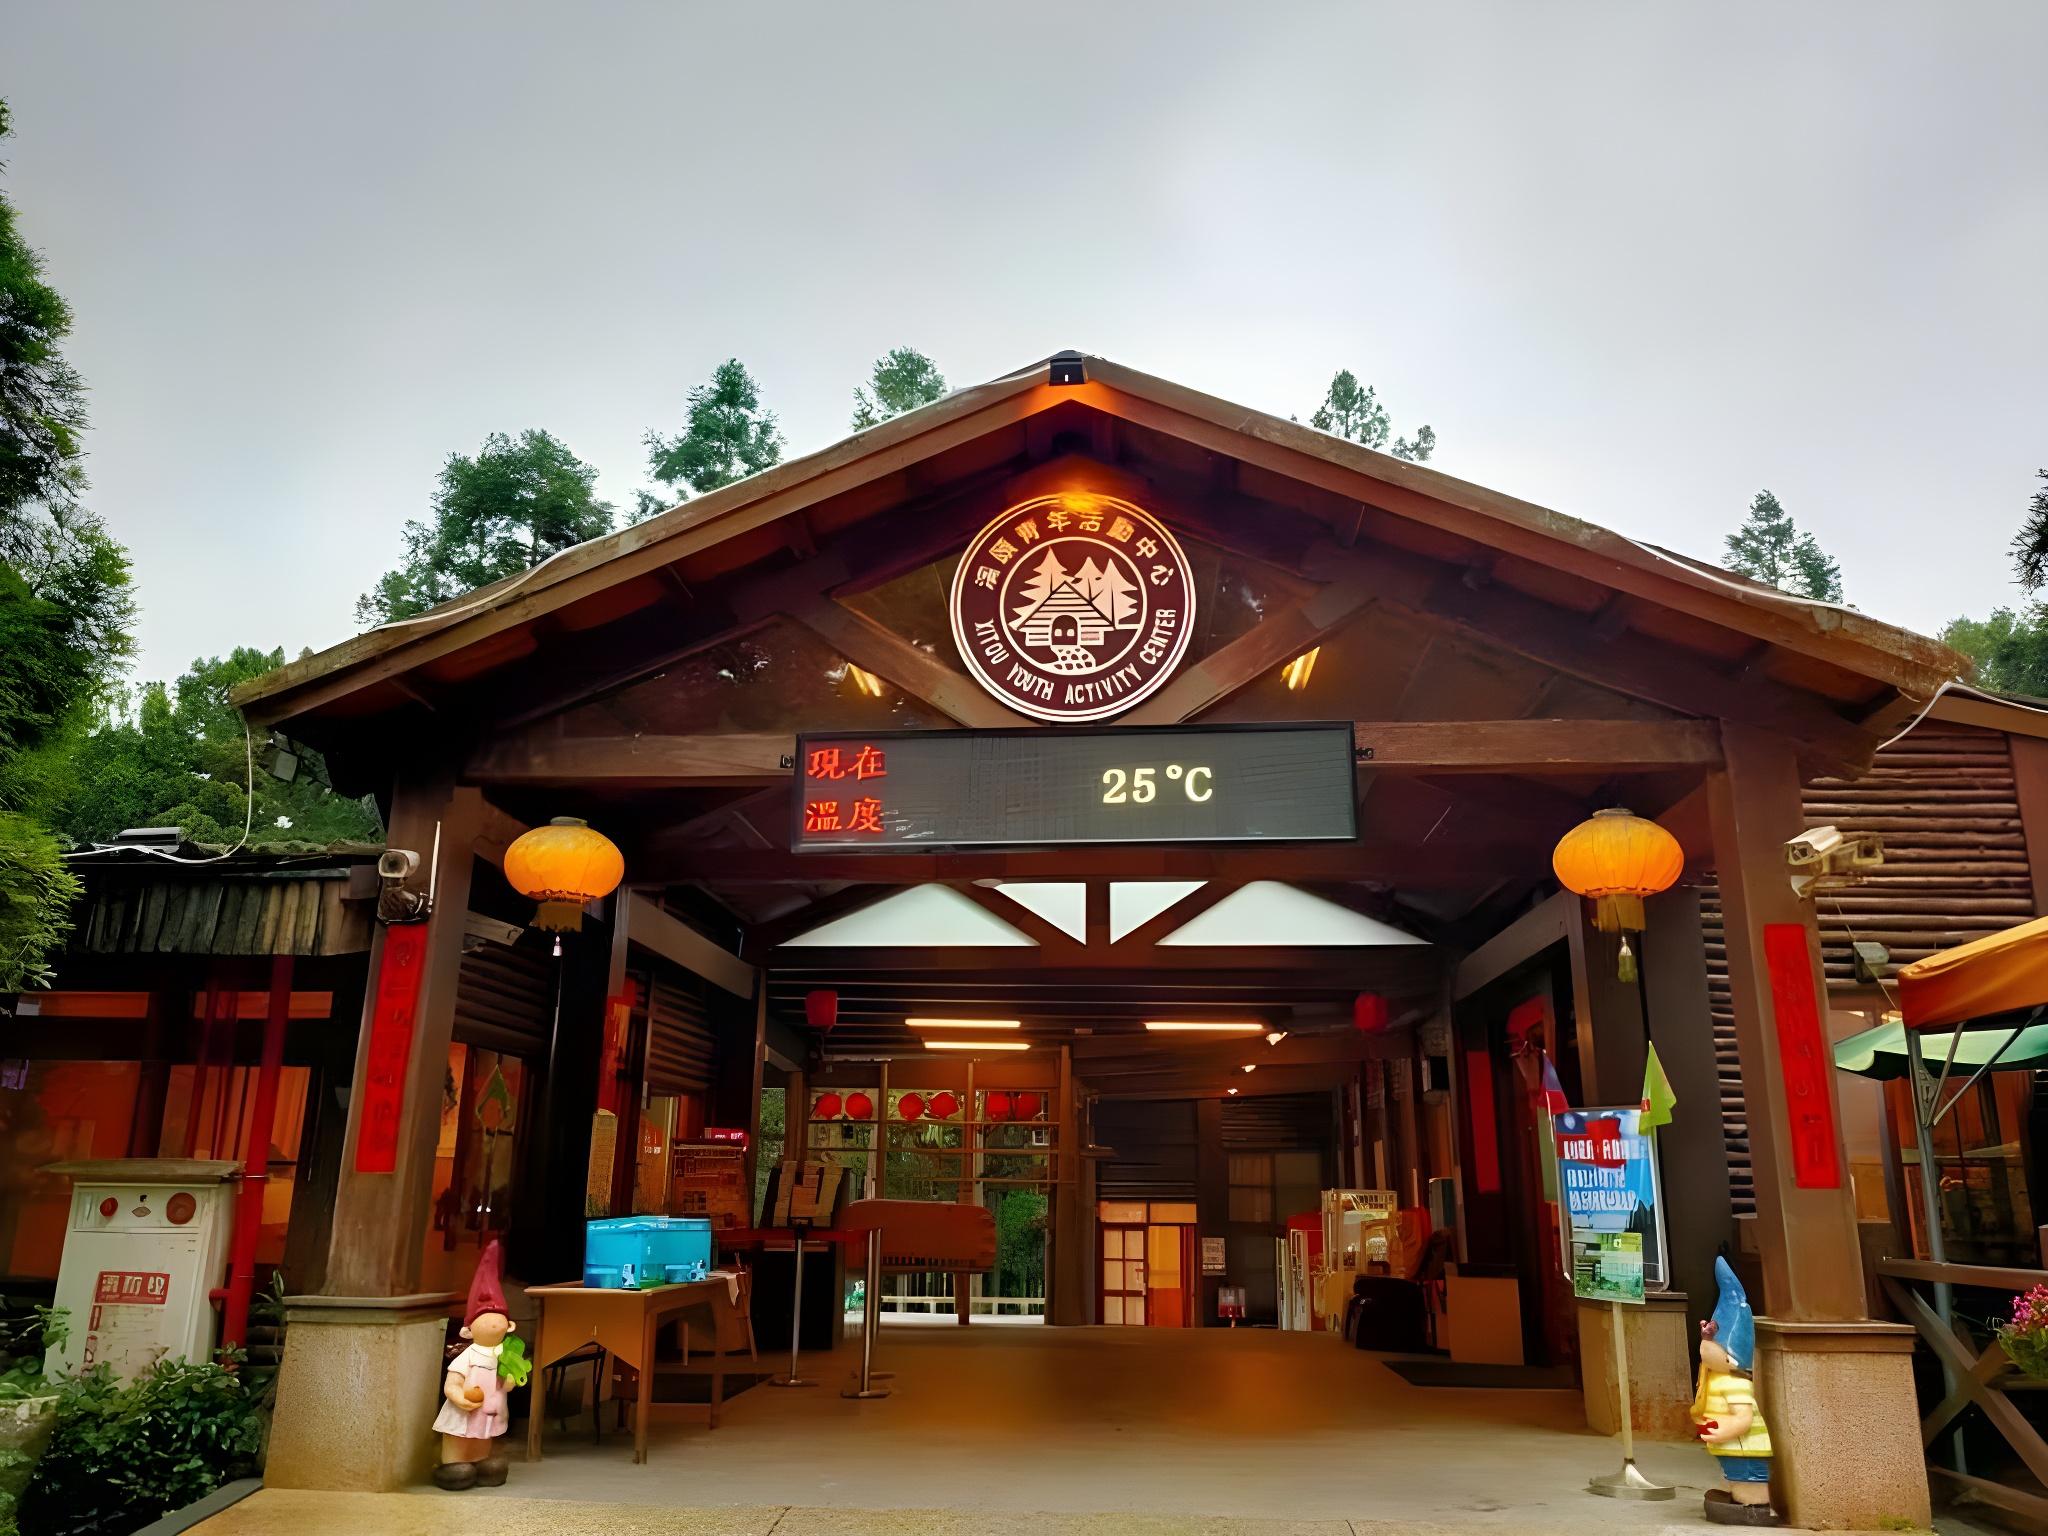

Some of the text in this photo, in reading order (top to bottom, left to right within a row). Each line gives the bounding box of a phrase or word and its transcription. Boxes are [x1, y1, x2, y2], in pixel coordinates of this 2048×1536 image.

[974, 617, 1010, 665] XITOU
[1006, 661, 1055, 701] YOUTH
[1064, 662, 1142, 705] ACTIVITY
[807, 745, 887, 780] 現在
[806, 798, 884, 832] 溫度
